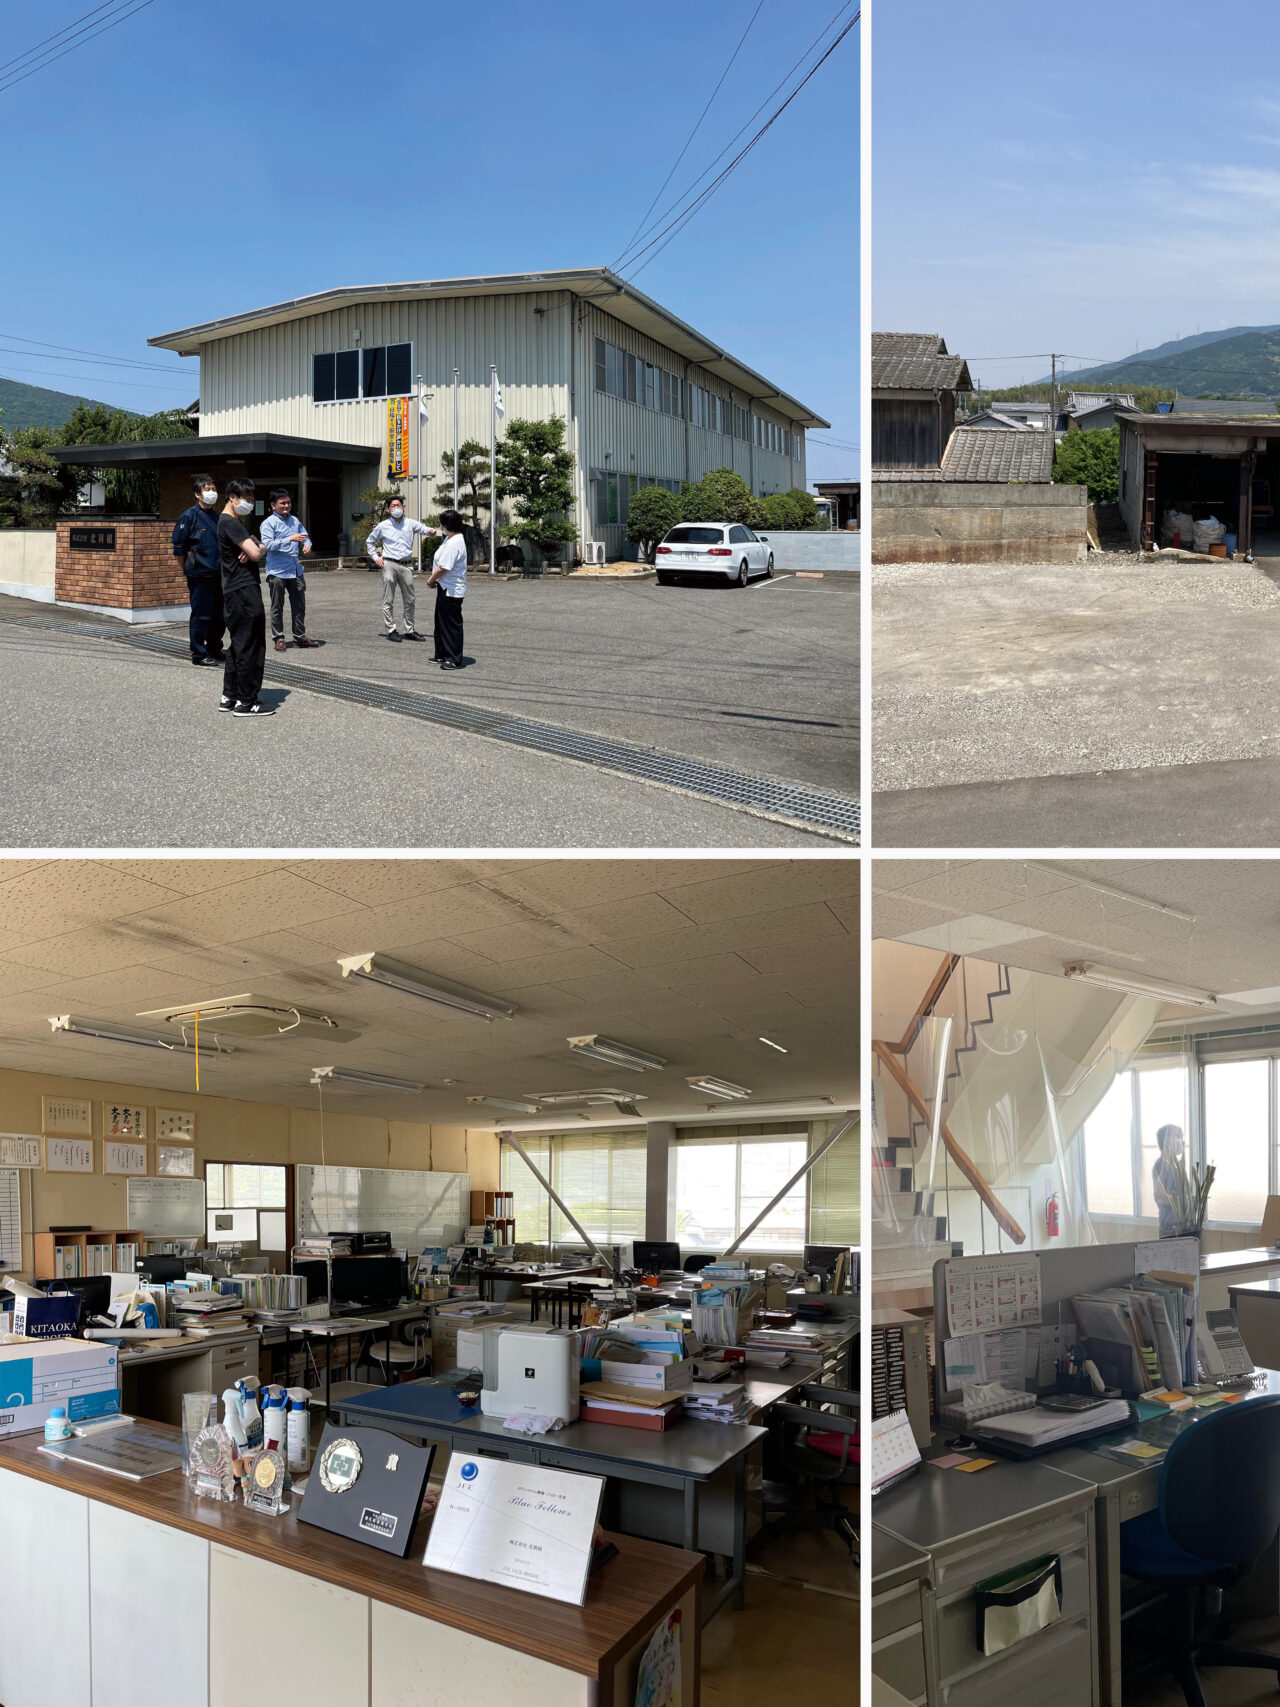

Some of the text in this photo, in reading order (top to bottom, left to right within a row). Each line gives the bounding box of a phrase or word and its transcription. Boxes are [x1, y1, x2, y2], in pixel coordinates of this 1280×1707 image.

[31, 1322, 77, 1334] KITAOKA
[456, 1483, 472, 1491] JFE
[508, 1496, 531, 1508] Blue
[534, 1501, 572, 1516] Fellows
